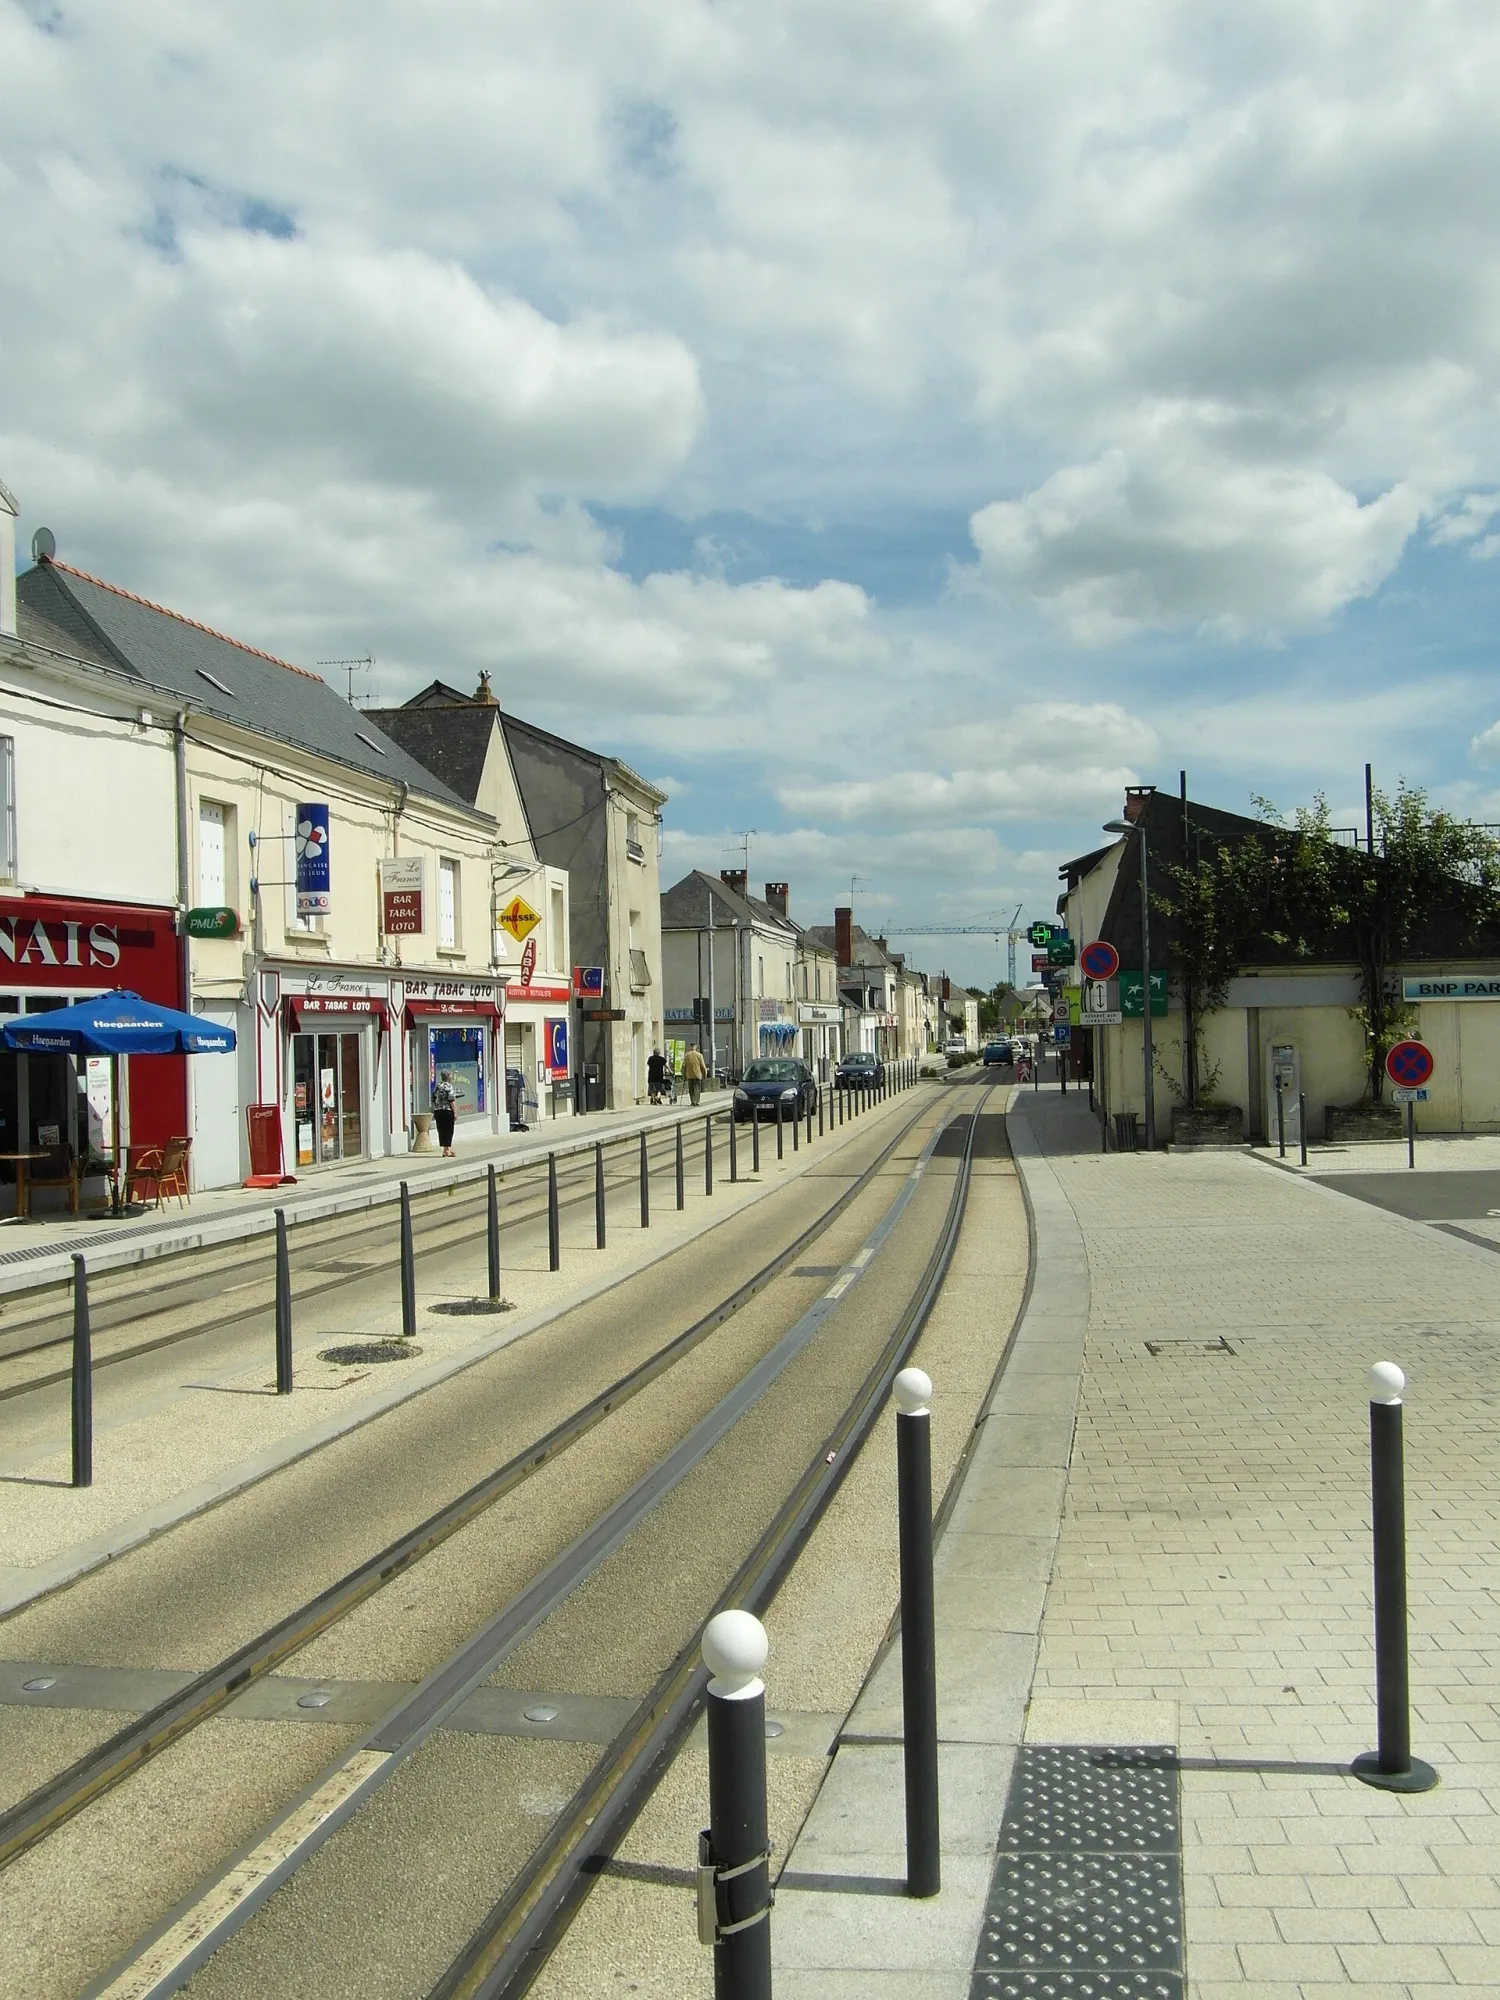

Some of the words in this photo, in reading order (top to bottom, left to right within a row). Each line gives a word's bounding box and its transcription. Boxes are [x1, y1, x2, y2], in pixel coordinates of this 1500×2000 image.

[405, 861, 419, 872] Le
[384, 872, 420, 884] France
[393, 895, 411, 904] BAR
[389, 908, 417, 918] TABAC
[501, 914, 535, 922] PRESSE
[190, 919, 214, 929] PMU
[391, 922, 415, 931] LOTO
[521, 939, 534, 985] TABAC
[307, 973, 322, 990] Le
[327, 975, 363, 992] France
[405, 981, 427, 995] BAR
[434, 983, 464, 996] TABAC
[470, 985, 491, 997] LOTO
[1420, 983, 1457, 994] BNP
[303, 1001, 319, 1010] BAR
[324, 1001, 348, 1010] TABAC
[352, 1002, 371, 1011] LOTO
[665, 1010, 694, 1019] BATEA
[715, 1009, 732, 1018] OLE
[93, 1020, 164, 1029] Hoegaarden
[33, 1034, 70, 1047] Hoegaarden
